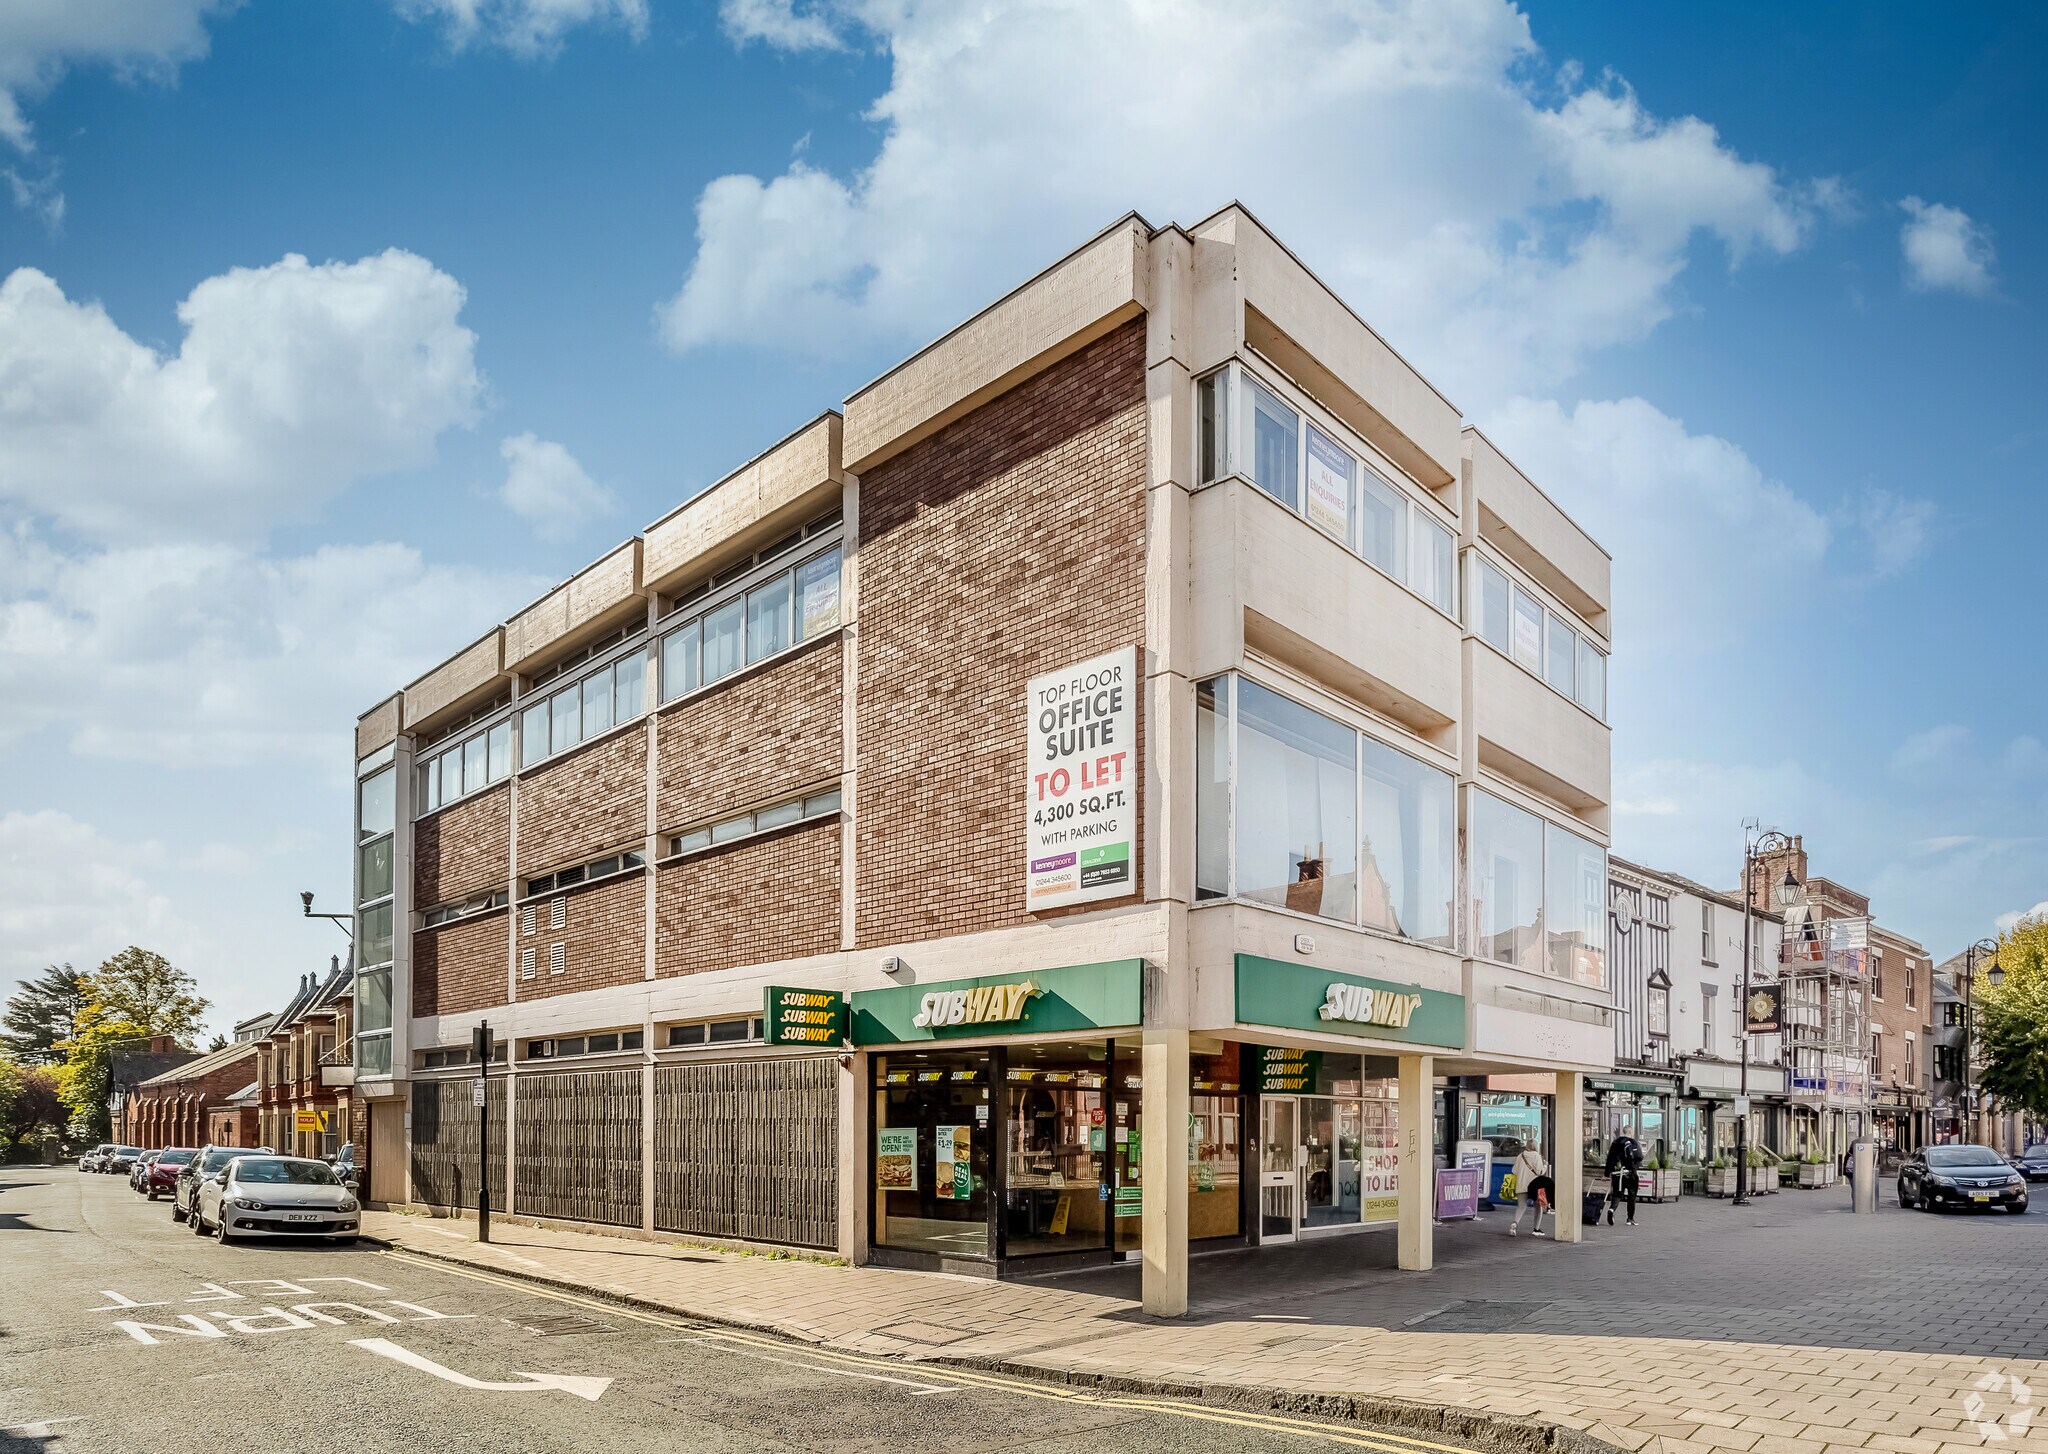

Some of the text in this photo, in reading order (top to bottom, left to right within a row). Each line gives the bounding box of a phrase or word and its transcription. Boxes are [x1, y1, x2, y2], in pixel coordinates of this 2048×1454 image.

[1321, 470, 1334, 487] ALL
[1310, 478, 1346, 512] ENQUIRIES
[815, 582, 828, 596] ALL
[1038, 665, 1122, 706] TOP FLOOR
[1039, 686, 1122, 734] OFFICE
[1046, 717, 1113, 761] SUITE
[1034, 751, 1127, 802] TO LET
[1033, 789, 1126, 828] 4,300 SQ.FT.
[1041, 819, 1118, 846] WITH PARKING
[1035, 856, 1072, 870] kenneymoore
[779, 992, 835, 1008] SUBWAY
[911, 978, 1042, 1029] SUBWAY
[1318, 982, 1423, 1029] SUBWAY
[779, 1009, 836, 1025] SUBWAY
[780, 1026, 836, 1042] SUBWAY
[1262, 1048, 1306, 1061] SUBWAY
[917, 1072, 943, 1082] SUBWAY
[950, 1070, 978, 1080] SUBWAY
[1006, 1071, 1036, 1081] SUBWAY
[1262, 1063, 1309, 1076] SUBWAY
[886, 1073, 911, 1083] SUBWAY
[1193, 1081, 1214, 1090] SUBWAY
[1262, 1077, 1309, 1090] SUBWAY
[1093, 1109, 1103, 1117] JUST
[880, 1135, 902, 1144] WE'RE
[938, 1139, 953, 1149] £1.29
[880, 1144, 902, 1153] OPEN!
[1369, 1154, 1399, 1171] SHOP
[954, 1172, 967, 1181] DEAL
[955, 1166, 968, 1175] REAL
[1366, 1175, 1380, 1192] TO
[1444, 1184, 1471, 1201] WOK&GO
[1366, 1200, 1381, 1210] 01244
[303, 1213, 318, 1221] XZZ
[87, 1276, 390, 1311] LEFT
[113, 1299, 477, 1345] TURN
